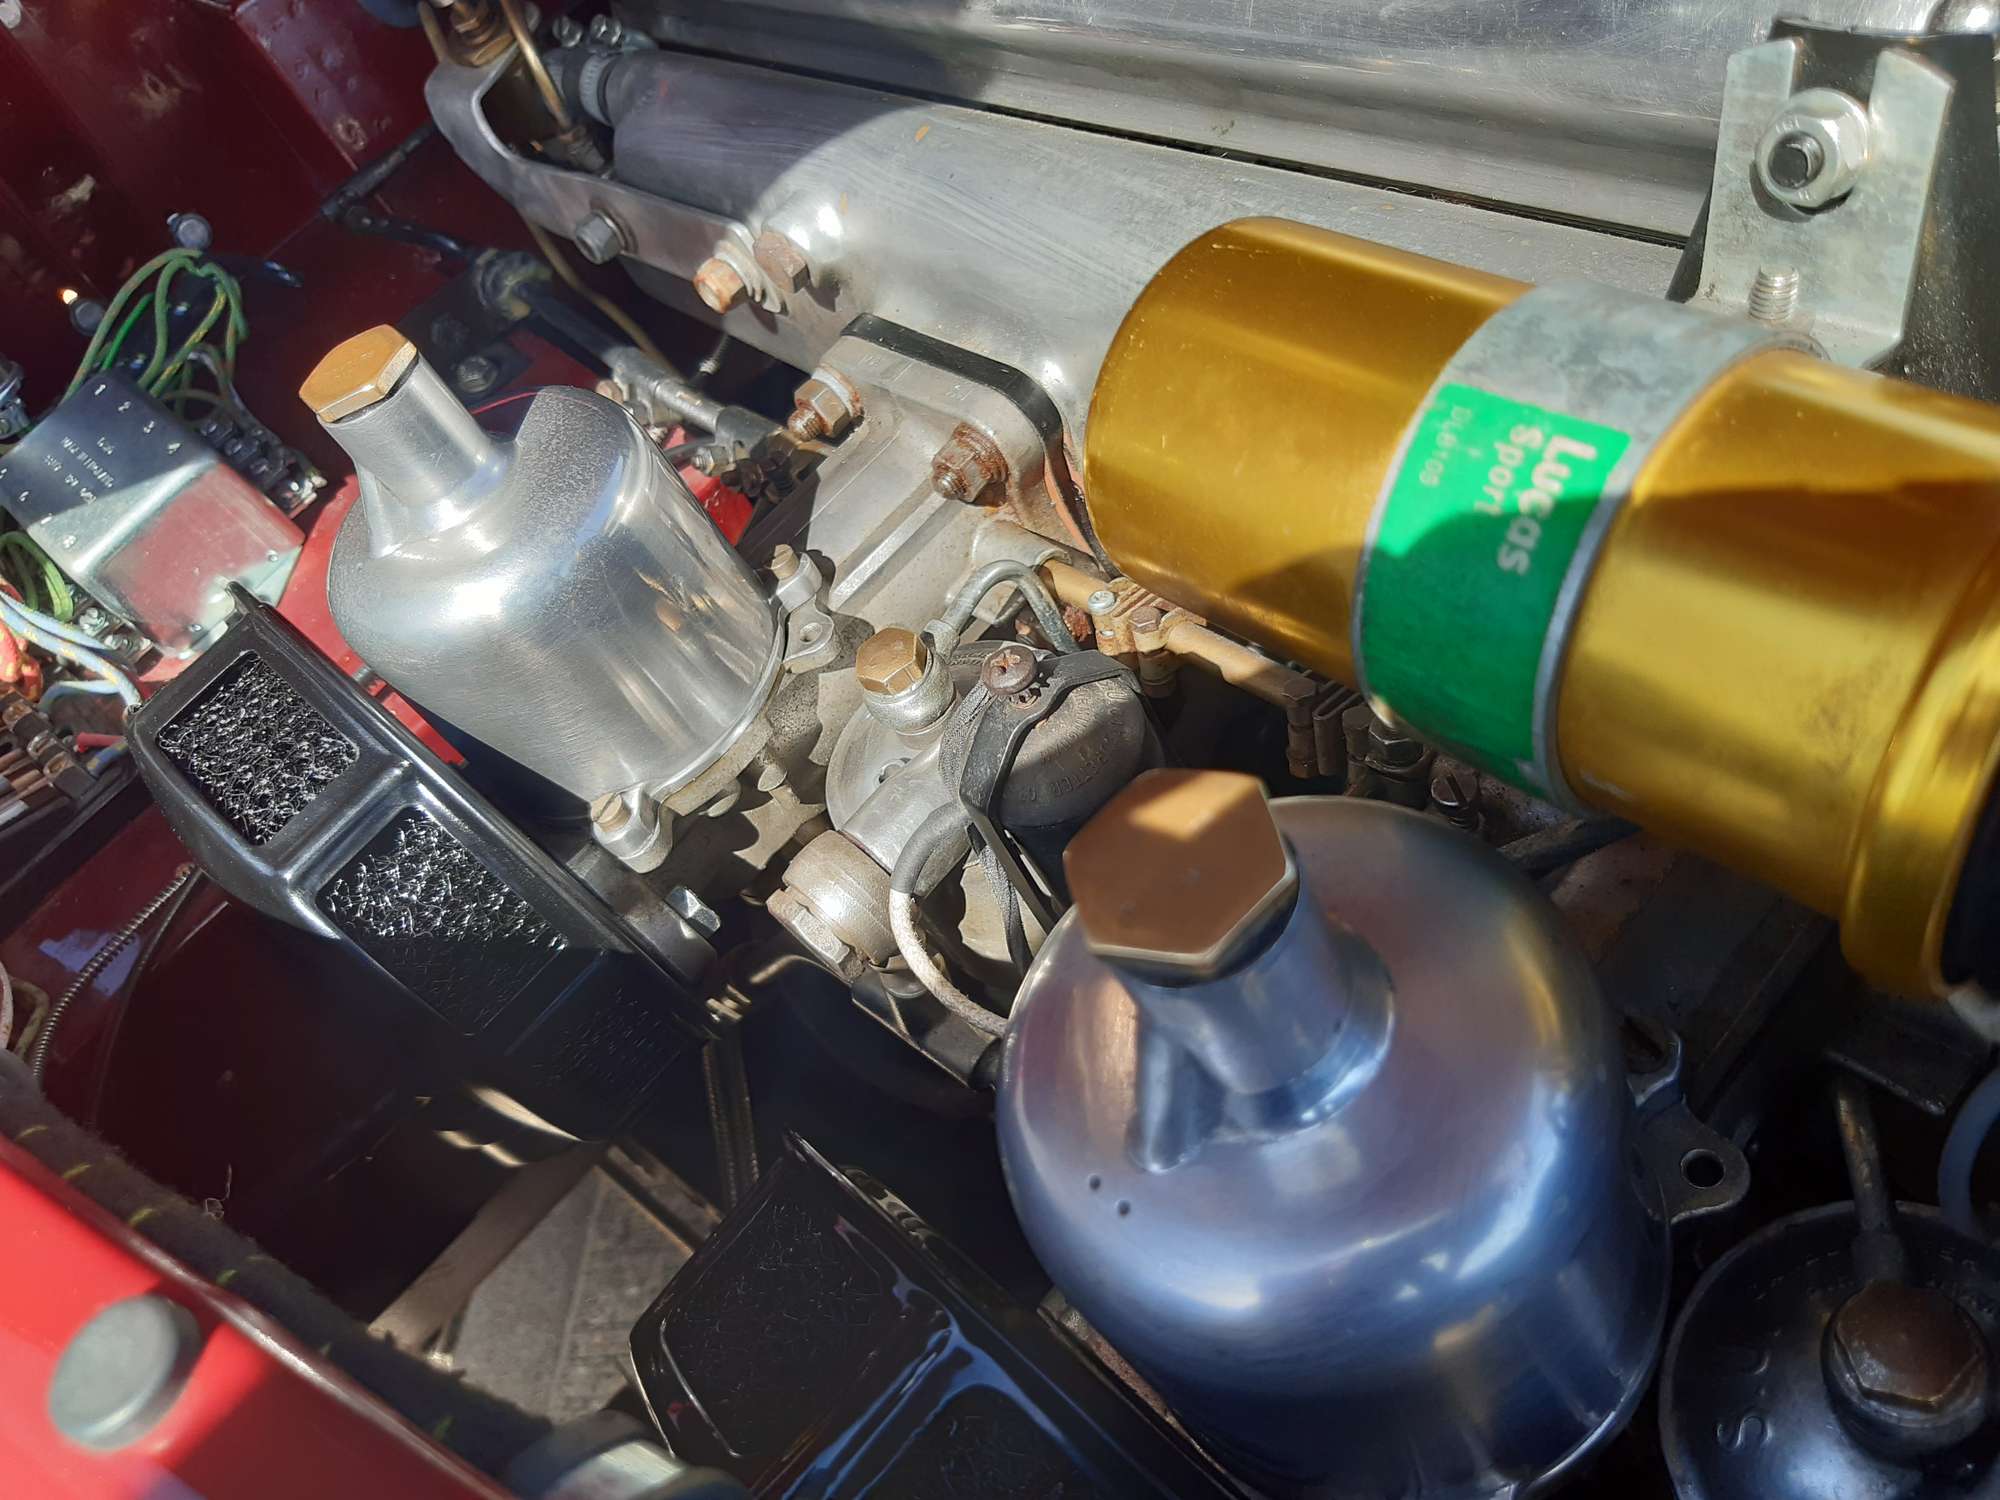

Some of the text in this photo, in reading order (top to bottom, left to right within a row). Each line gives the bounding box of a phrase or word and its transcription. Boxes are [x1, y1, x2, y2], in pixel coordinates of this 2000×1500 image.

[94, 383, 106, 396] 1
[117, 400, 132, 414] 2
[1473, 424, 1545, 516] Sport
[1497, 434, 1598, 576] Lucas
